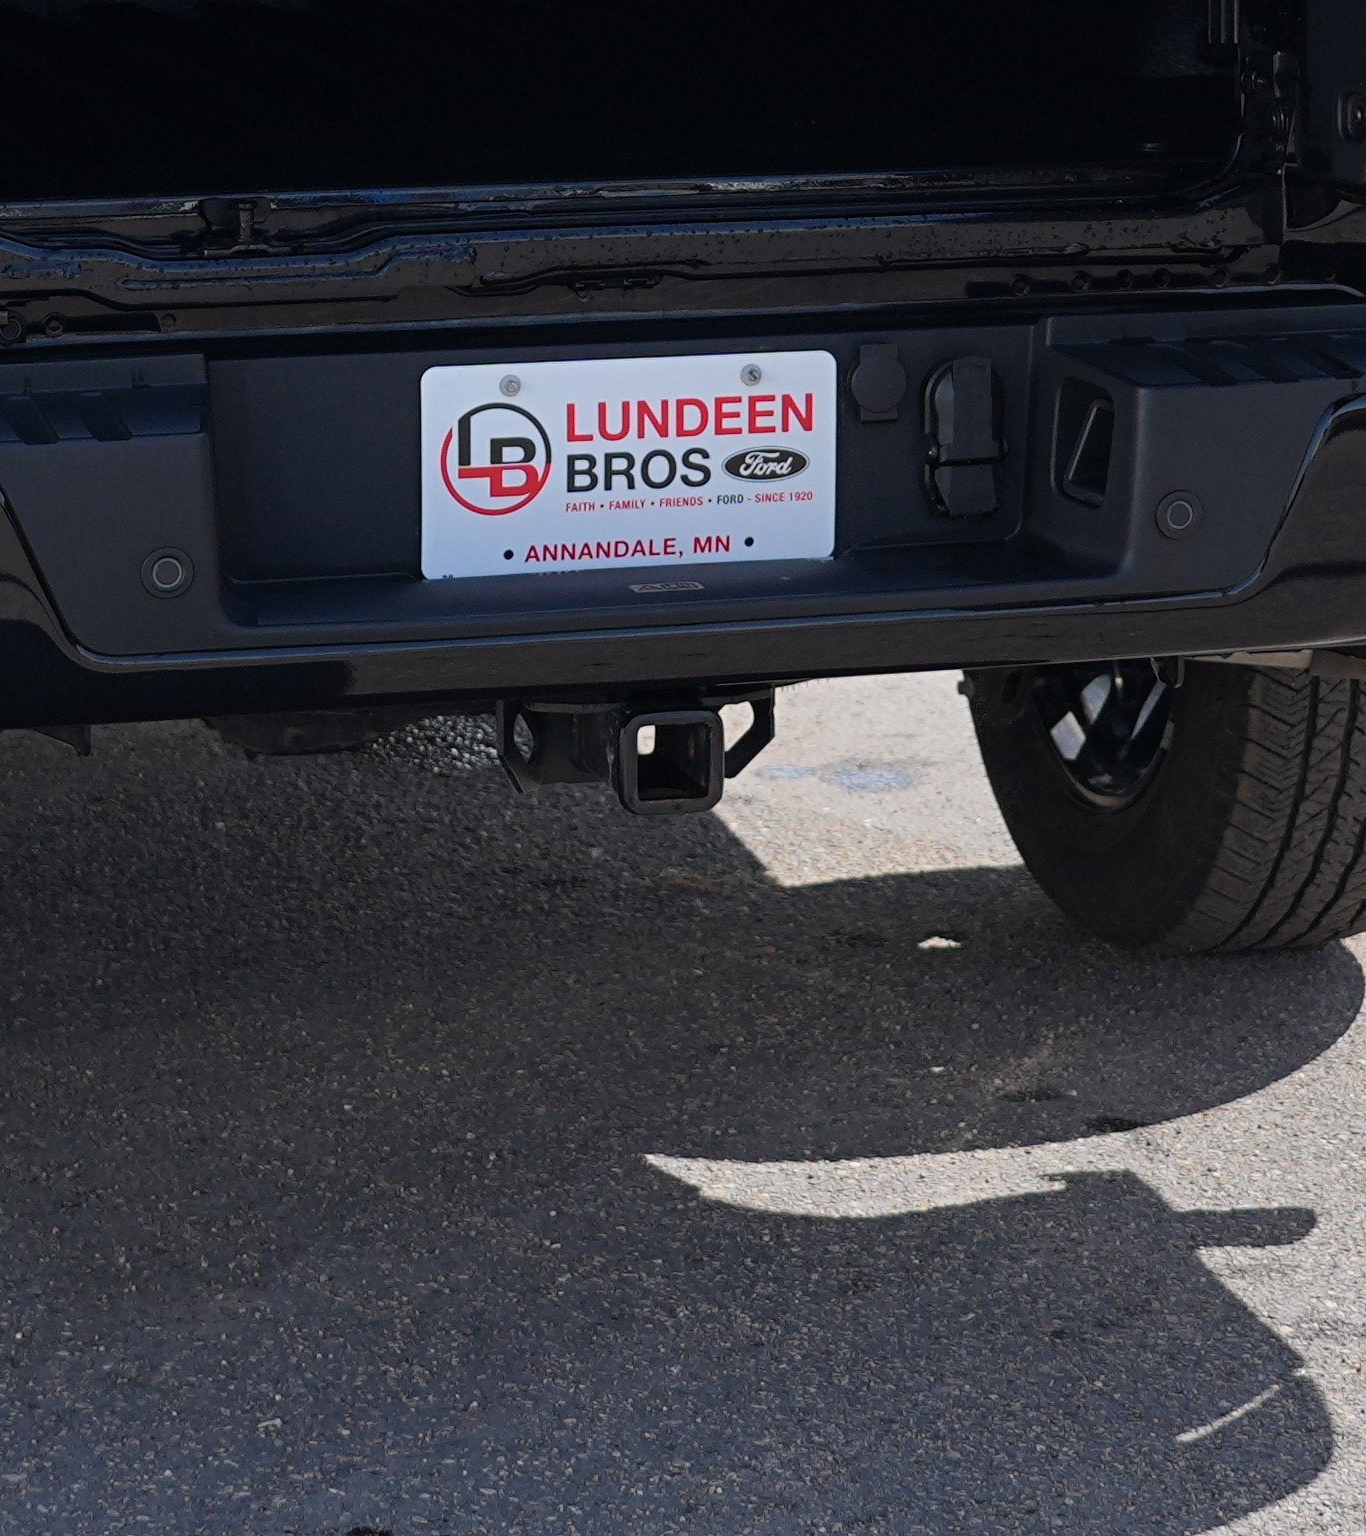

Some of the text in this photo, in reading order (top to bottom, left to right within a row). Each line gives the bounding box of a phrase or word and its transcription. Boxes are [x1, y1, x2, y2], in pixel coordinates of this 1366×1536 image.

[566, 393, 814, 443] LUNDEEN
[566, 447, 712, 493] BROS
[738, 451, 793, 477] Ford
[565, 501, 596, 513] FAITH
[608, 498, 646, 510] FAMILY
[659, 496, 704, 508] FRIENDS
[716, 494, 744, 505] FORD
[754, 492, 785, 503] SINCE
[789, 491, 814, 502] 1920
[524, 534, 732, 563] ANNANDALE, MN
